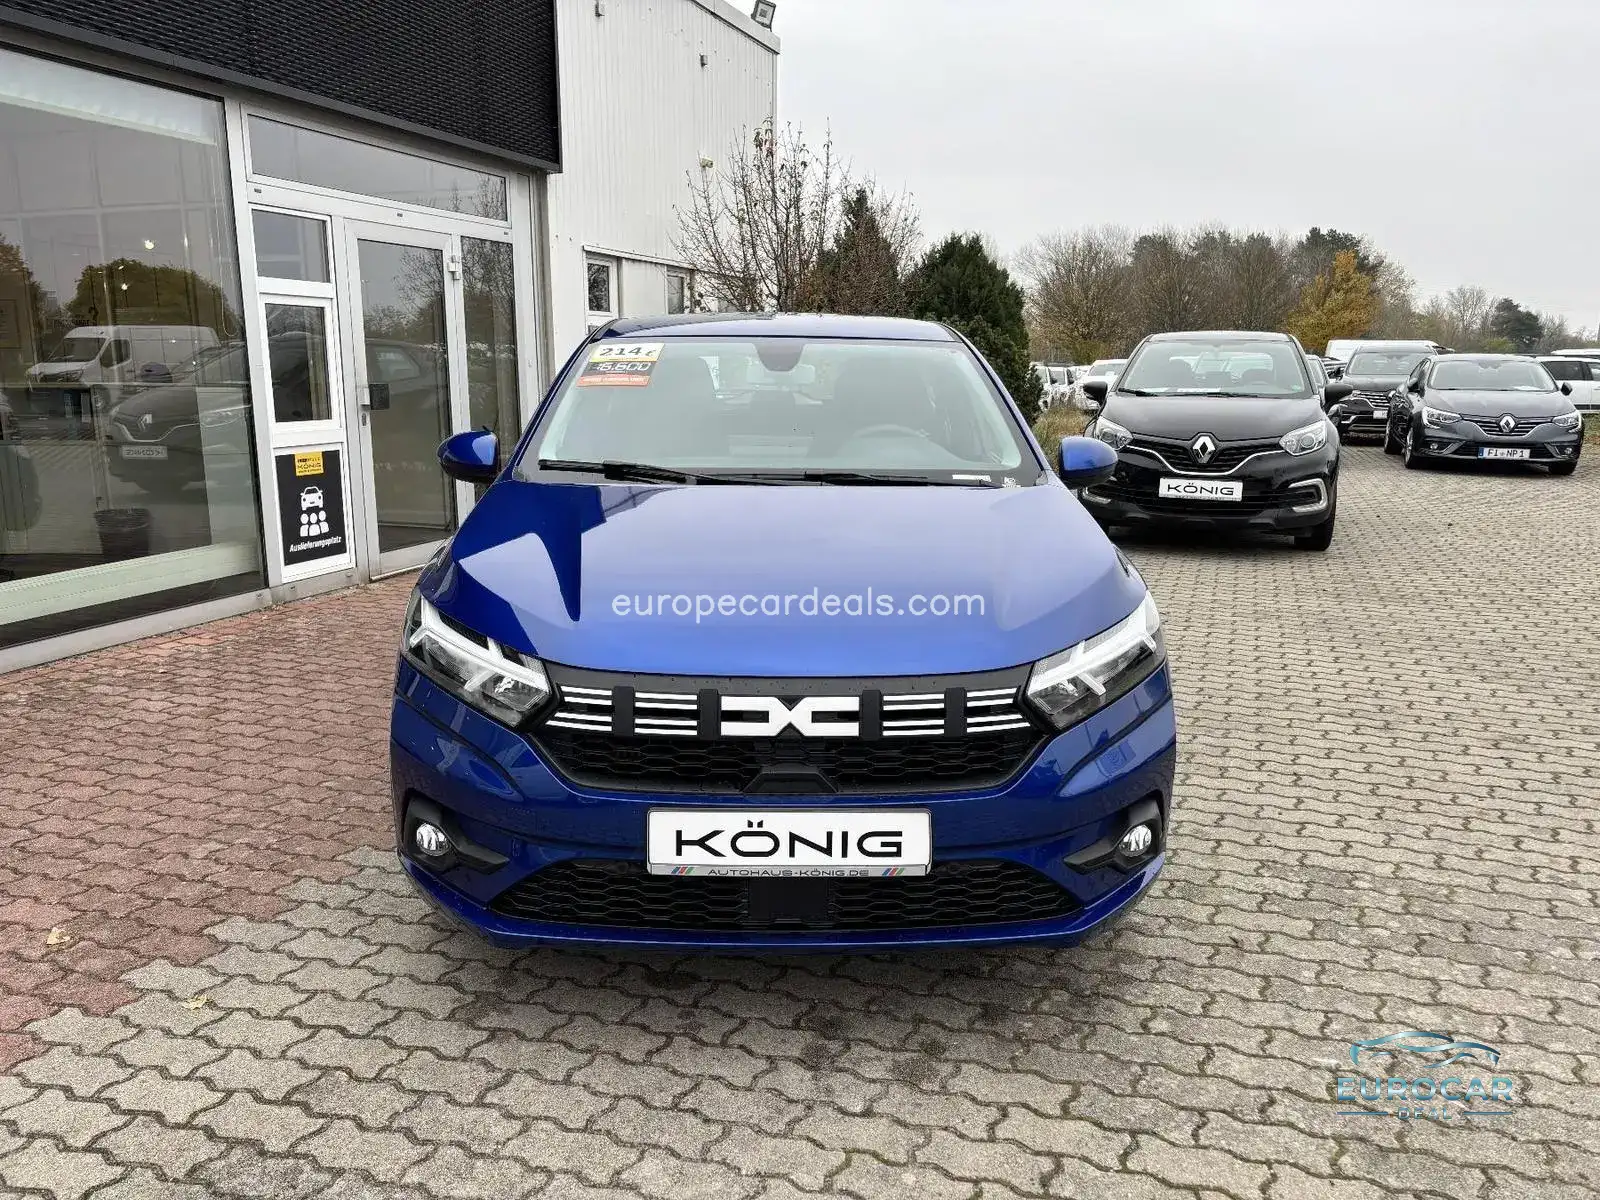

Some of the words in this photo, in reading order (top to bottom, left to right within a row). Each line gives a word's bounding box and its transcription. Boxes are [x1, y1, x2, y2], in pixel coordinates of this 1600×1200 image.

[1167, 482, 1234, 496] KÖNIG
[289, 536, 342, 553] Auslieferungsplatz
[675, 819, 903, 858] KÖNIG
